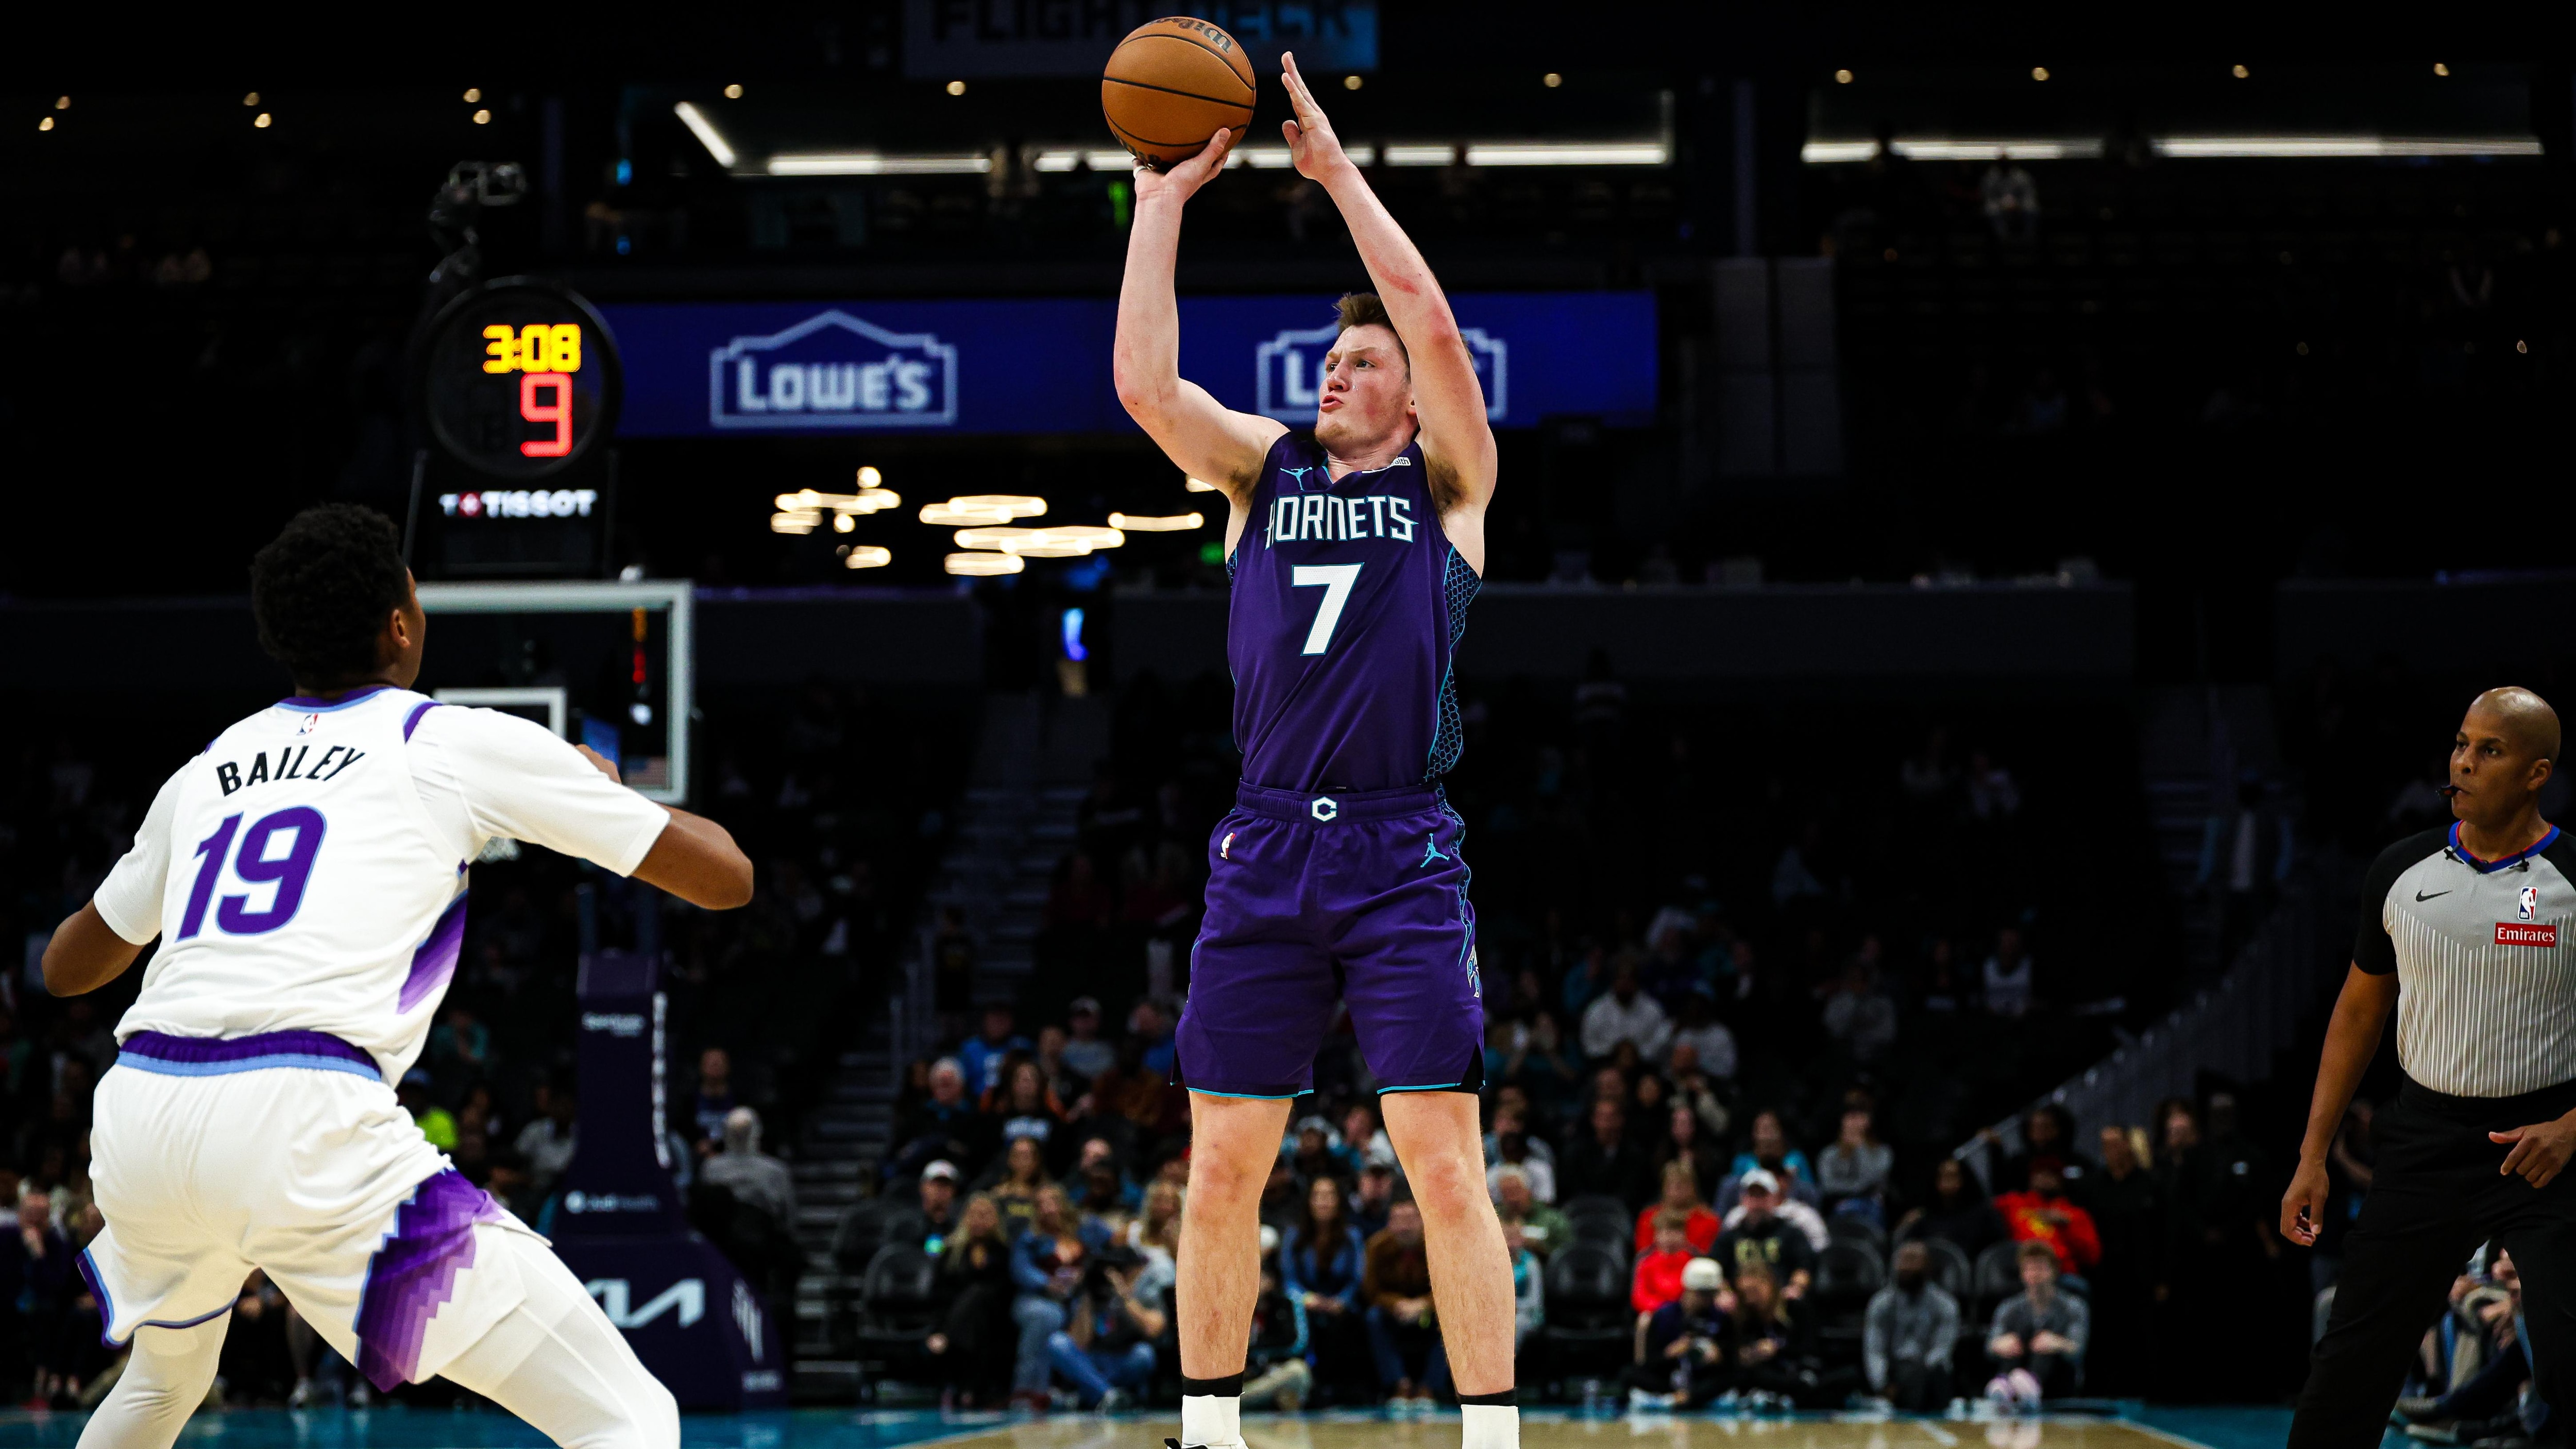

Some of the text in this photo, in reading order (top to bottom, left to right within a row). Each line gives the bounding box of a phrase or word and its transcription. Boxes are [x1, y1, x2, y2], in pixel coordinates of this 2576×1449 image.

[483, 323, 582, 374] 3:08
[738, 353, 930, 411] LOWE'S
[520, 372, 573, 458] 9
[1264, 493, 1418, 551] HORNETS
[1291, 562, 1365, 657] 7
[216, 745, 366, 797] BAILEY
[175, 805, 327, 943] 19
[2497, 927, 2555, 943] Emirates
